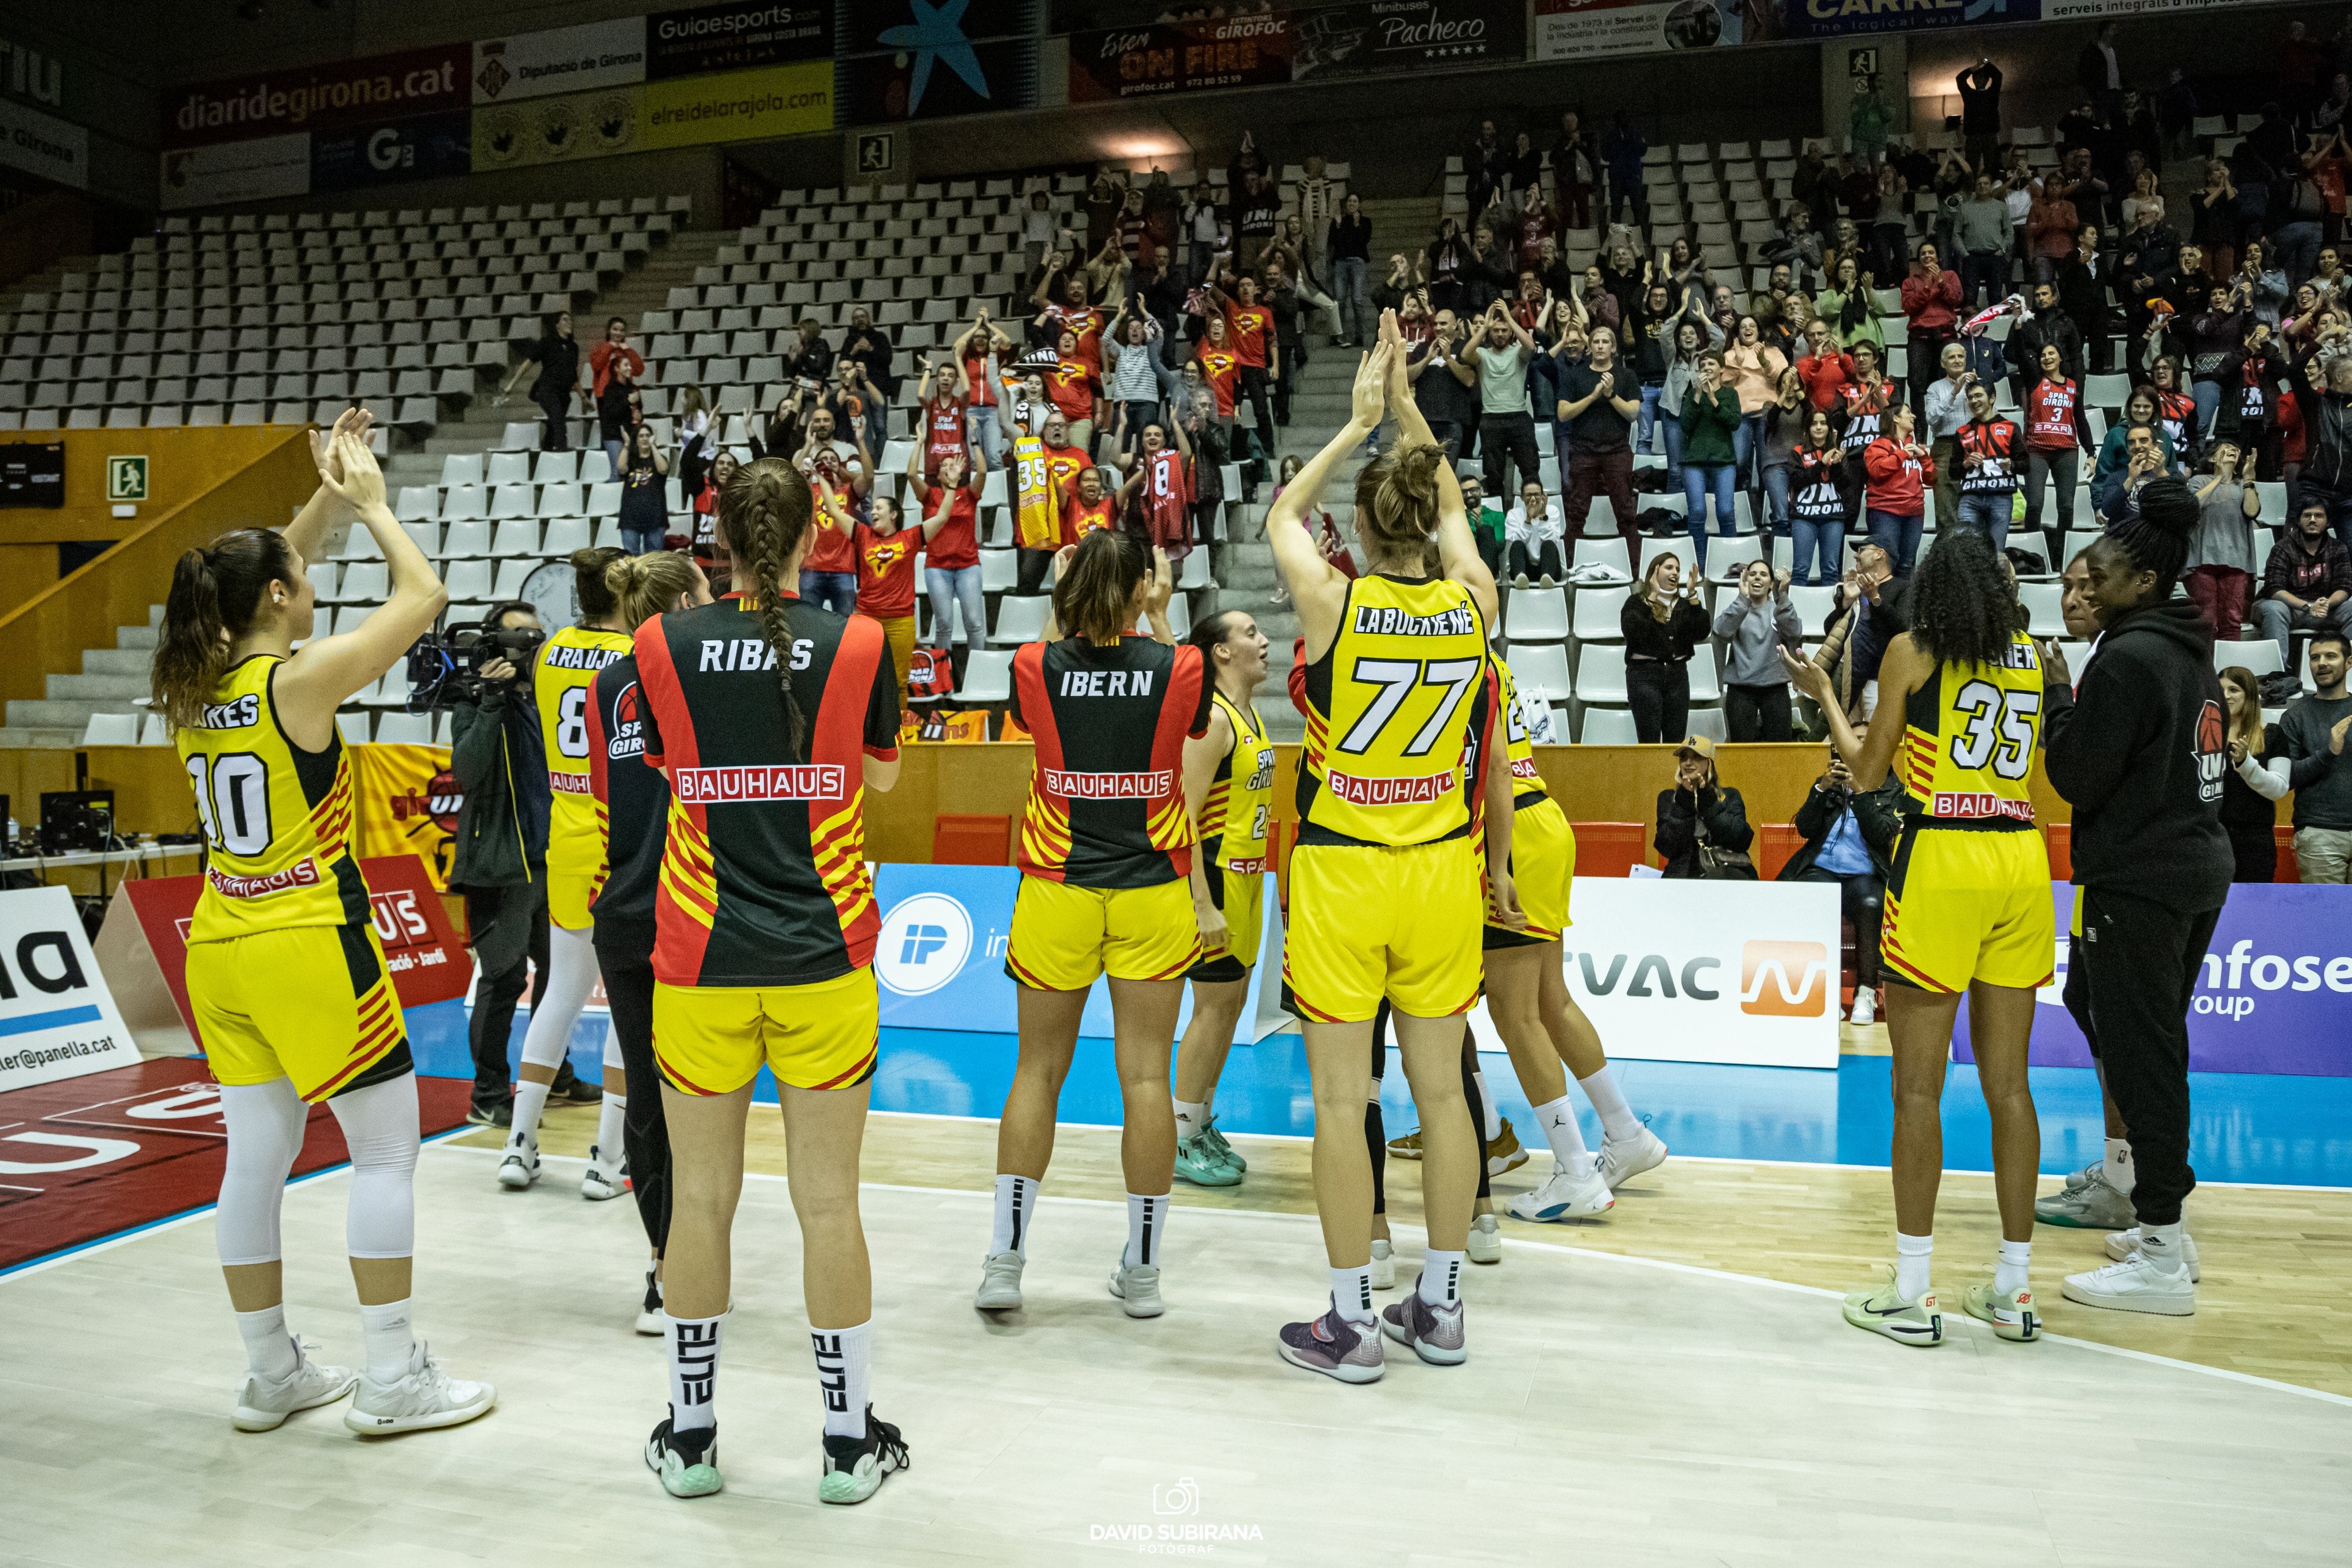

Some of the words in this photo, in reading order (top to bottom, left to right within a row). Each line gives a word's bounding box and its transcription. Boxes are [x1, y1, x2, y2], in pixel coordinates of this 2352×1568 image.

[2053, 3, 2103, 16] serveis
[1215, 20, 1287, 40] GIROFOC
[1379, 6, 1486, 47] Pacheco
[1811, 23, 1841, 34] The
[1851, 17, 1916, 31] logical
[1925, 15, 1960, 25] way
[580, 56, 598, 71] de
[598, 51, 643, 68] Girona
[1119, 48, 1175, 81] ON
[1184, 40, 1259, 76] FIRE
[177, 59, 455, 131] diaridegirona.cat
[1120, 81, 1176, 97] girofoc.cat
[2042, 398, 2074, 408] GIRONA
[2048, 392, 2068, 400] SPAR
[1844, 413, 1881, 438] UN
[2034, 423, 2068, 433] SPAR
[2051, 408, 2063, 422] 3
[1840, 434, 1881, 449] GIRO
[1019, 457, 1047, 493] 35
[1060, 670, 1154, 697] IBERN
[1337, 656, 1481, 756] 77
[557, 685, 590, 758] 8
[1949, 678, 2041, 781] 35
[680, 769, 841, 799] BAUHAUS
[1046, 772, 1171, 799] BAUHAUS
[185, 752, 274, 857] 10
[1563, 951, 1722, 1001] VAC
[2195, 939, 2352, 994] nfose
[1925, 1296, 1936, 1307] GT
